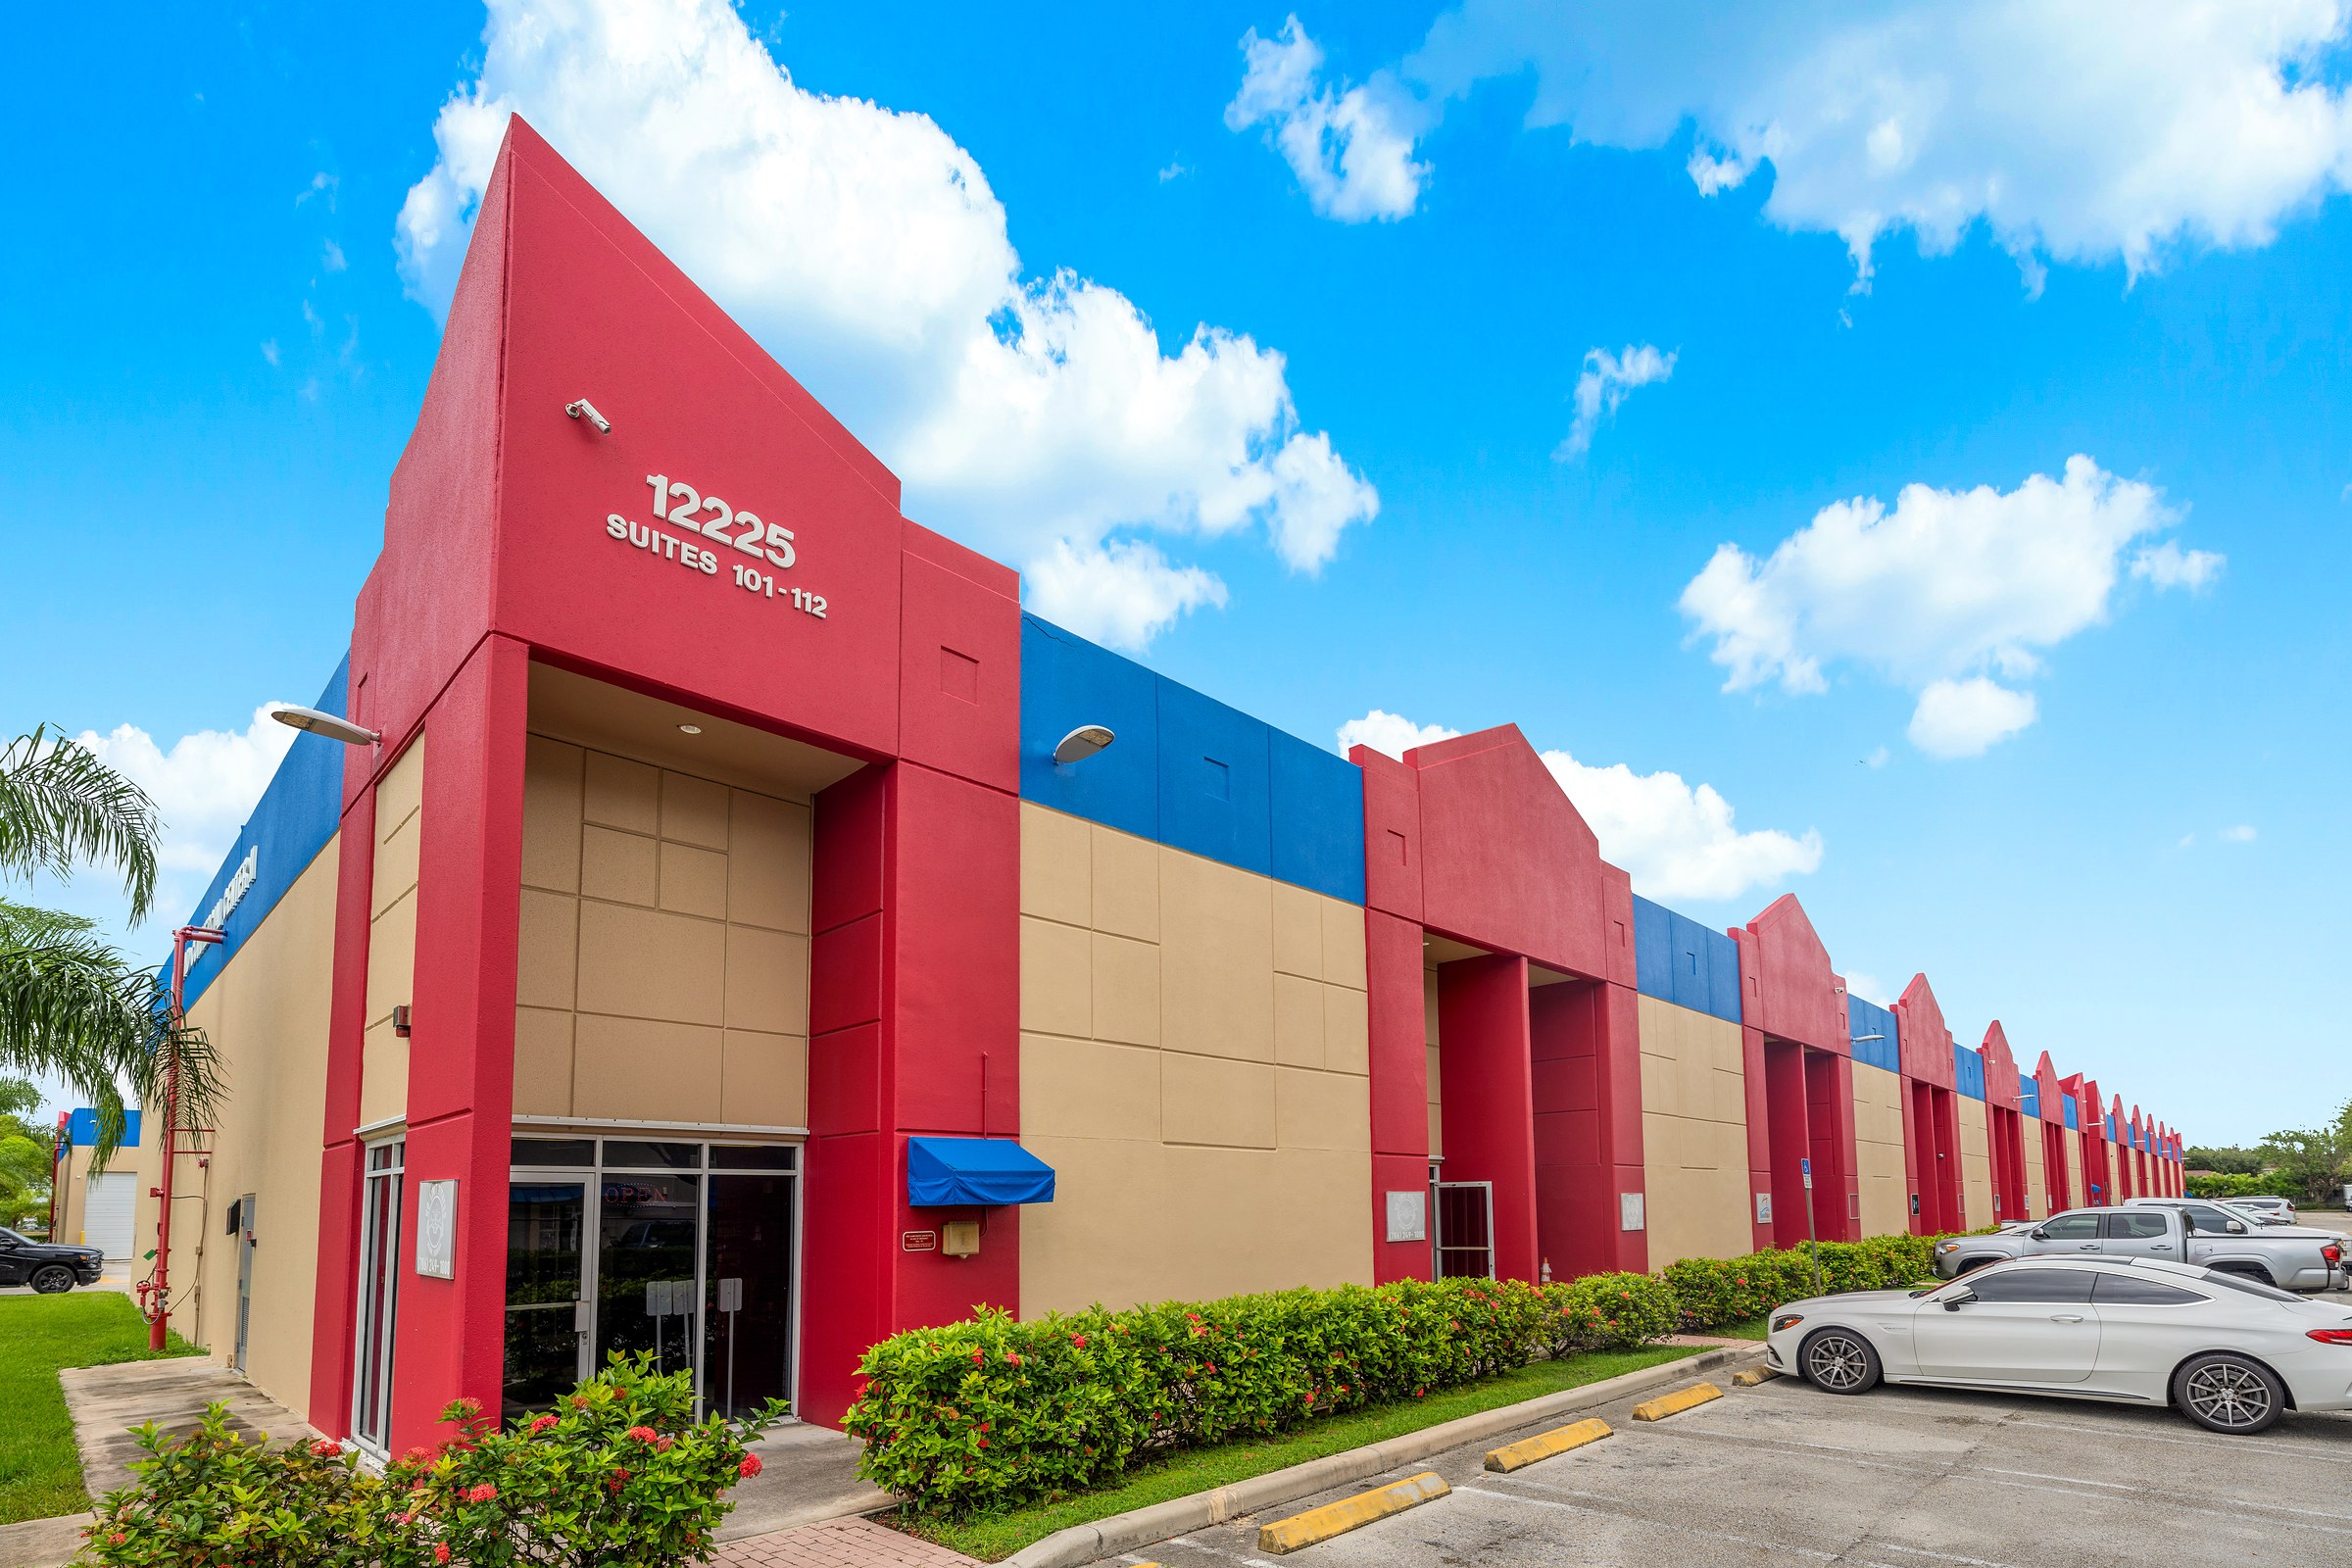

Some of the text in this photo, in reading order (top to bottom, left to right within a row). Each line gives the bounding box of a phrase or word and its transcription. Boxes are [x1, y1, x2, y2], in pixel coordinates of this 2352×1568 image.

[606, 514, 717, 575] SUITES
[646, 473, 796, 569] 12225
[605, 1187, 667, 1203] OPEN
